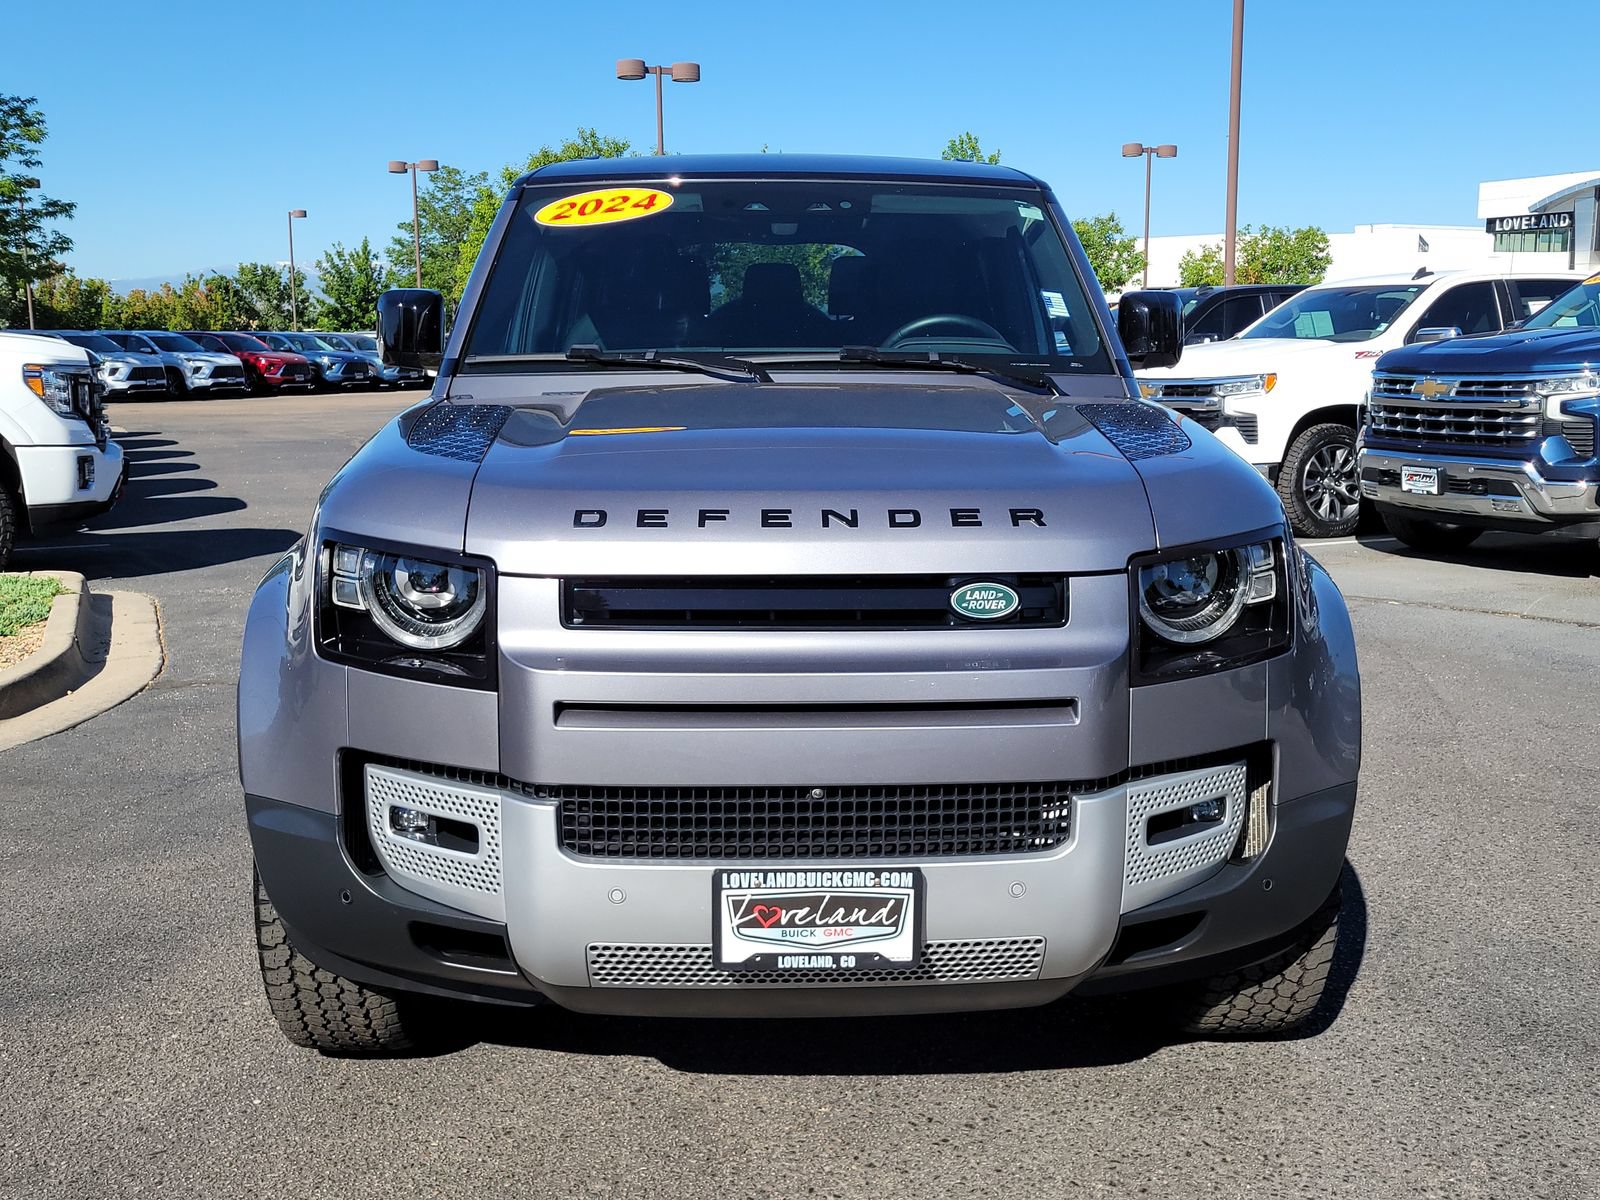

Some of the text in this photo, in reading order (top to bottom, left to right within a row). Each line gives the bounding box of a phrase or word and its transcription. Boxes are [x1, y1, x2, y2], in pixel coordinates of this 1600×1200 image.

[549, 193, 658, 222] 2024
[1495, 213, 1570, 231] LOVELAND
[573, 508, 1047, 528] DEFENDER
[722, 872, 913, 888] LOVELANDBUICKGMC.COM
[781, 928, 854, 938] BUICK GMC
[778, 955, 856, 969] LOVELAND, CO
